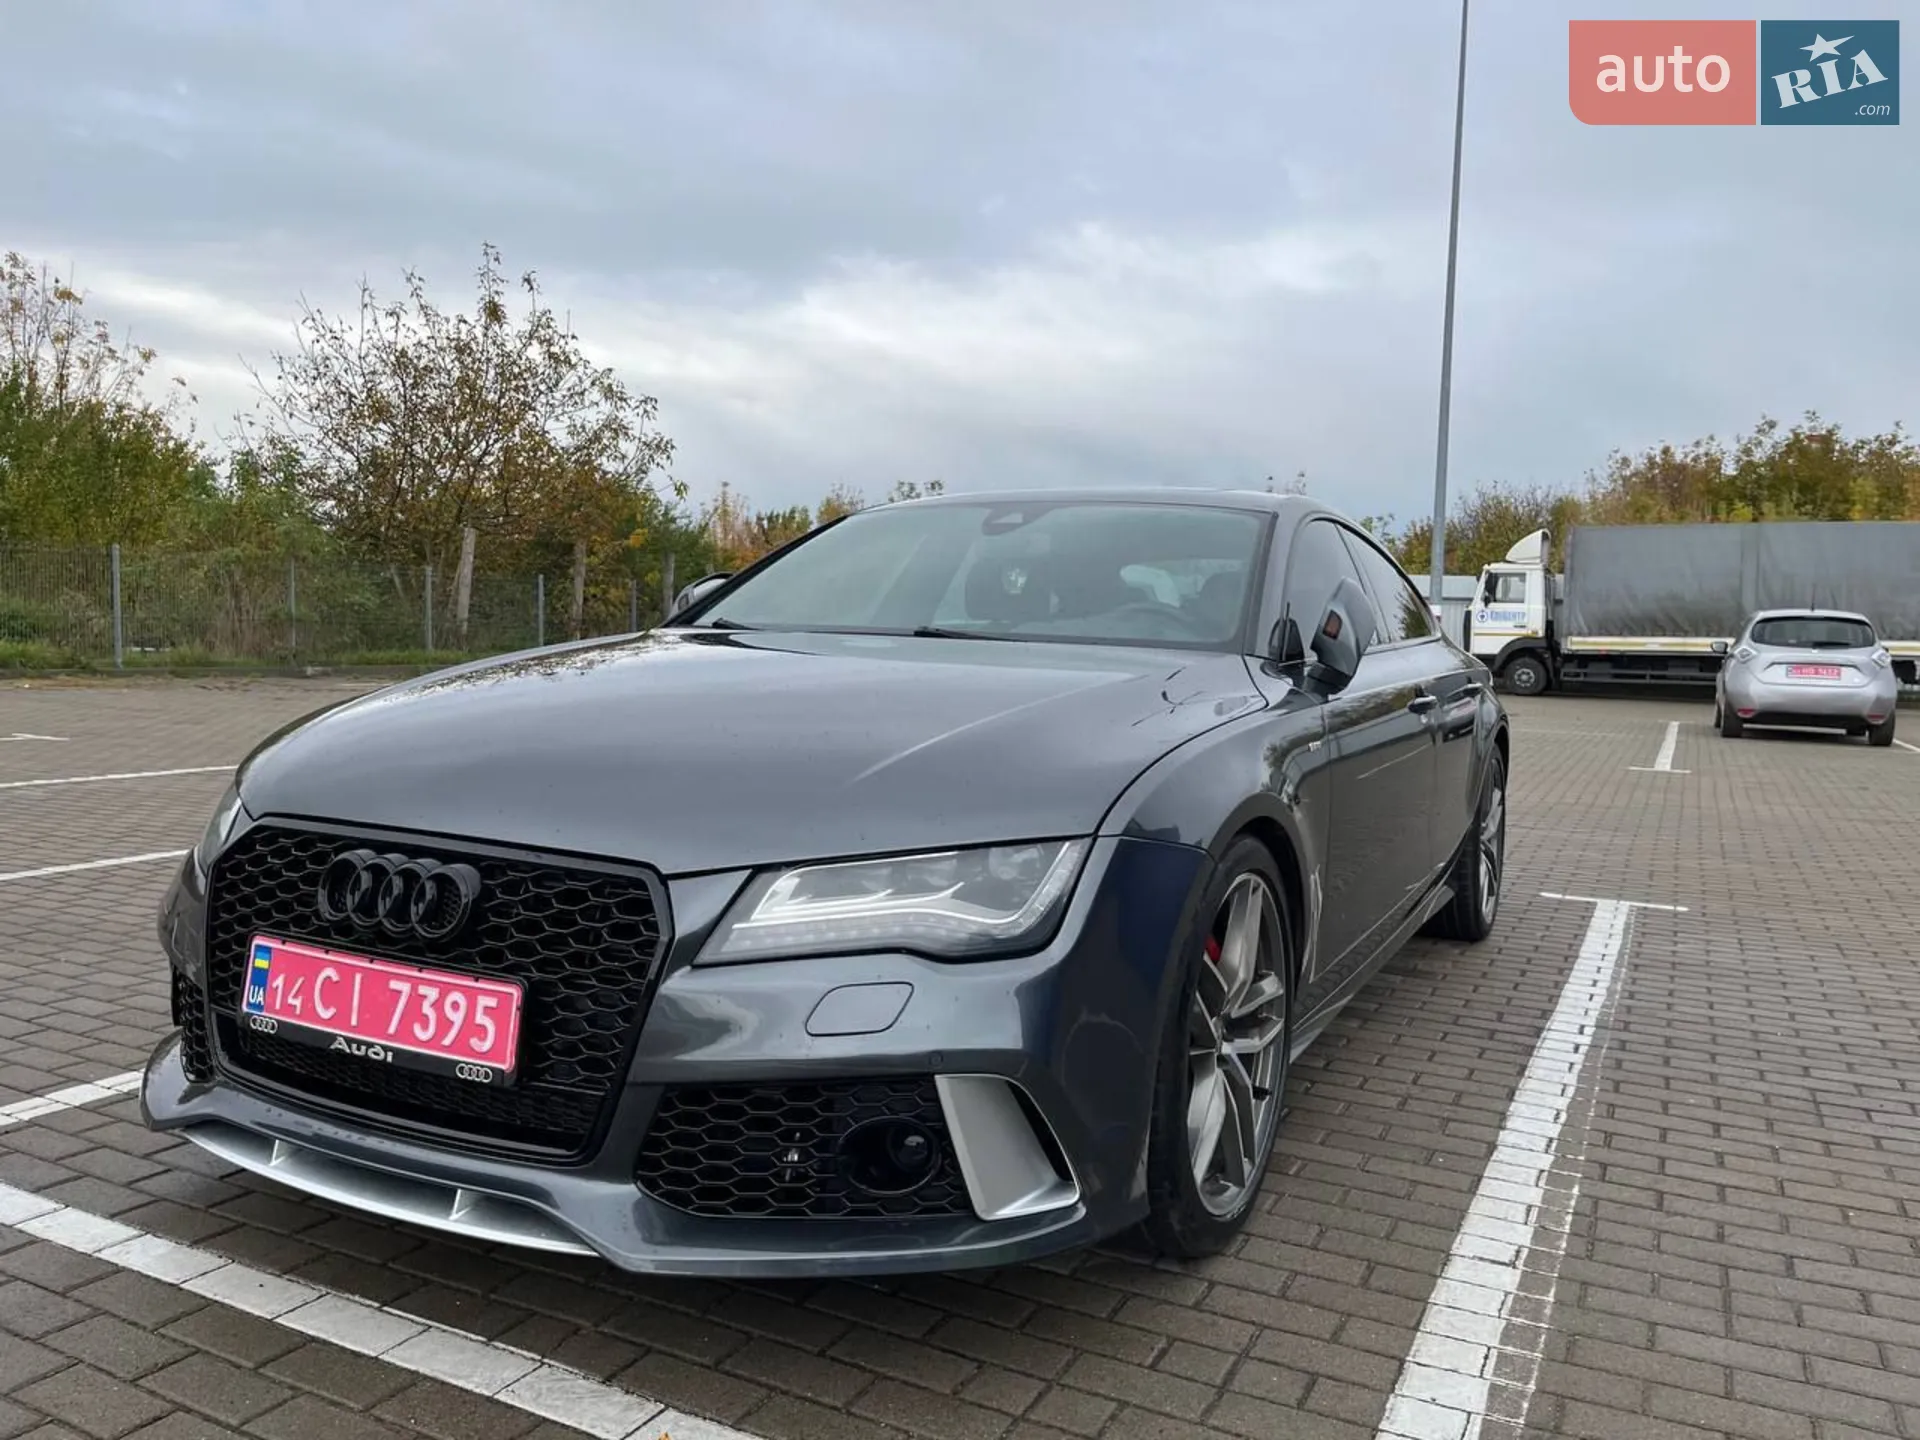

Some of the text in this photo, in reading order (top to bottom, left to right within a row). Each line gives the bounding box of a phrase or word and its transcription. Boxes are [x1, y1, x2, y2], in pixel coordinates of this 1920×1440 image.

[249, 984, 265, 1006] UA
[387, 979, 499, 1054] 7395
[330, 1036, 394, 1064] Audi
